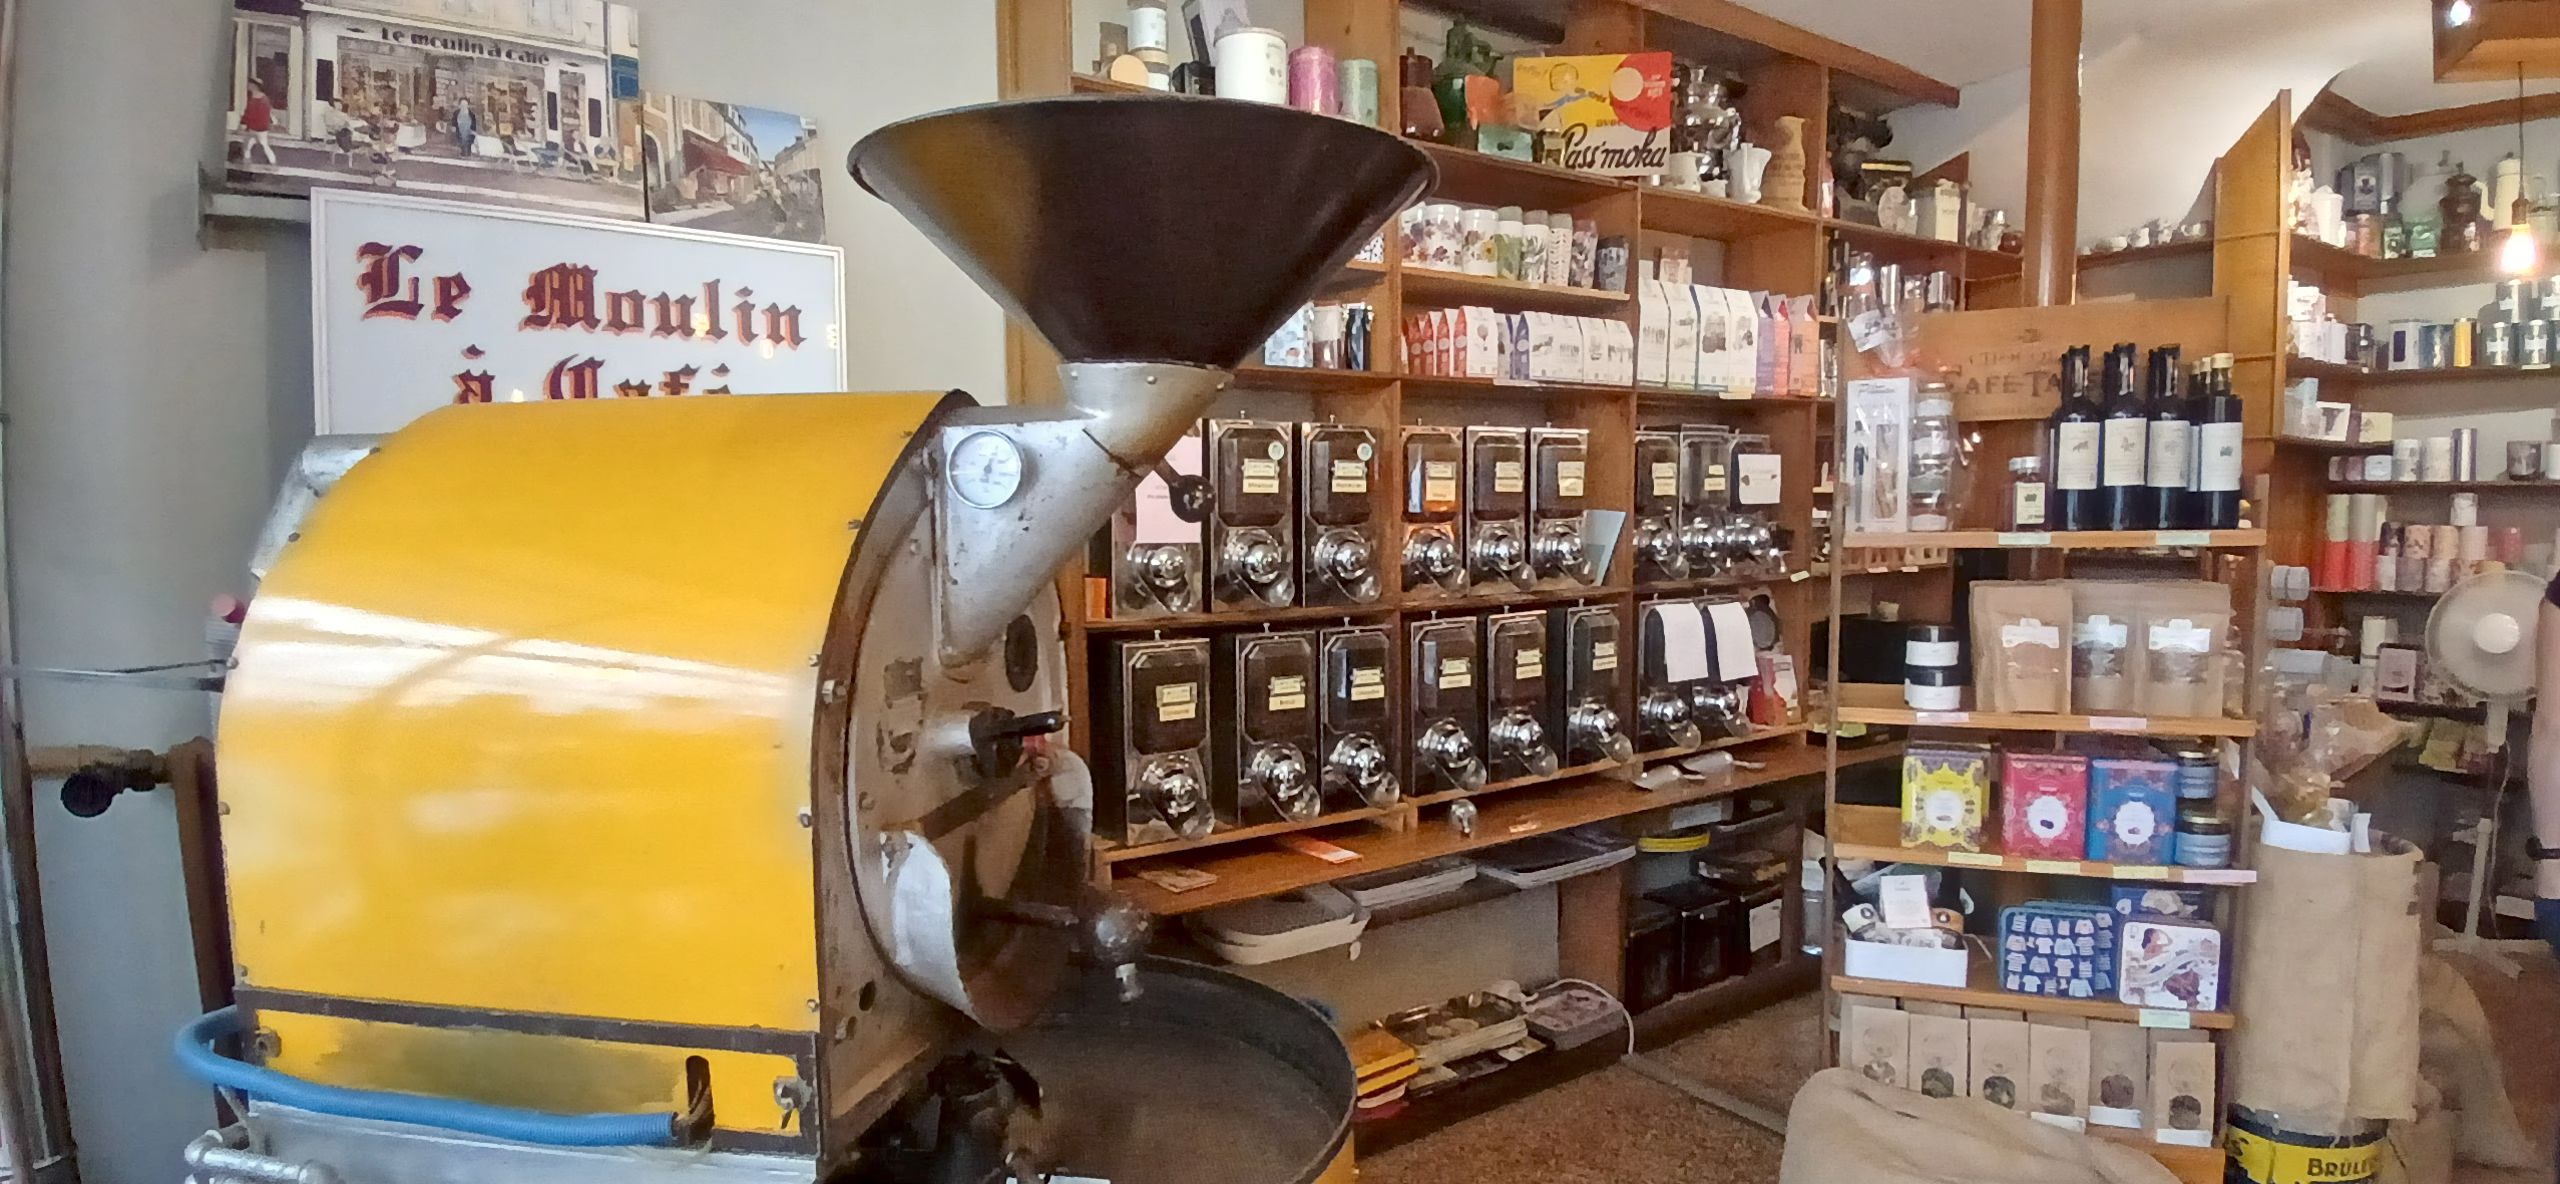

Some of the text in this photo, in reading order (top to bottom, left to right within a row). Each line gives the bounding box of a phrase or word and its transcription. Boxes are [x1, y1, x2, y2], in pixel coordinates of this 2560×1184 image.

[410, 33, 484, 55] moulin
[356, 241, 806, 350] Le Moulin
[452, 343, 496, 404] à
